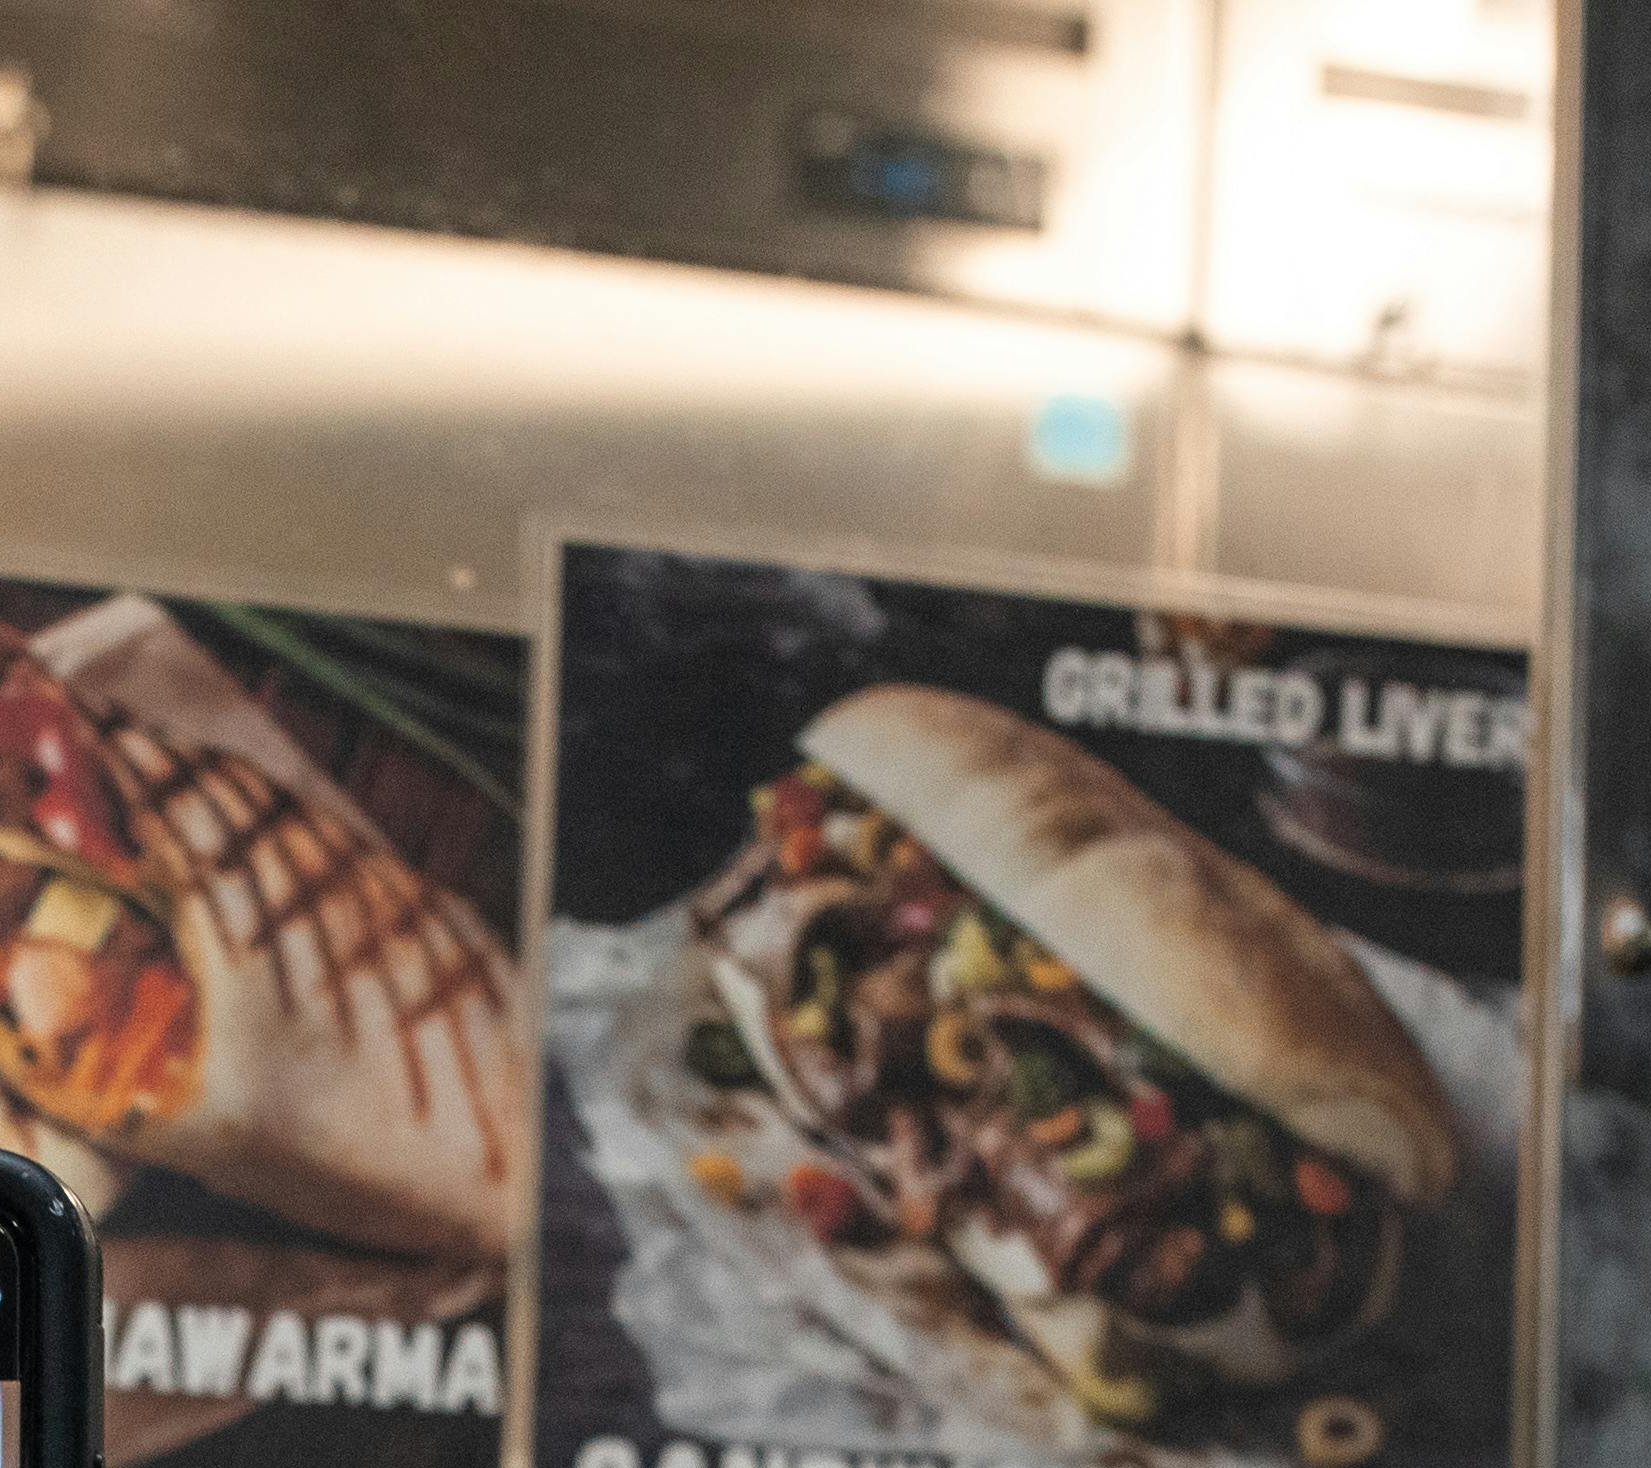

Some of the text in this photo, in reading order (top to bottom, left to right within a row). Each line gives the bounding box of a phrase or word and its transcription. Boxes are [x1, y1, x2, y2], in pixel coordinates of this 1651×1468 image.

[1041, 646, 1534, 768] GRILLED LIVER
[104, 1298, 500, 1418] AWARMA
